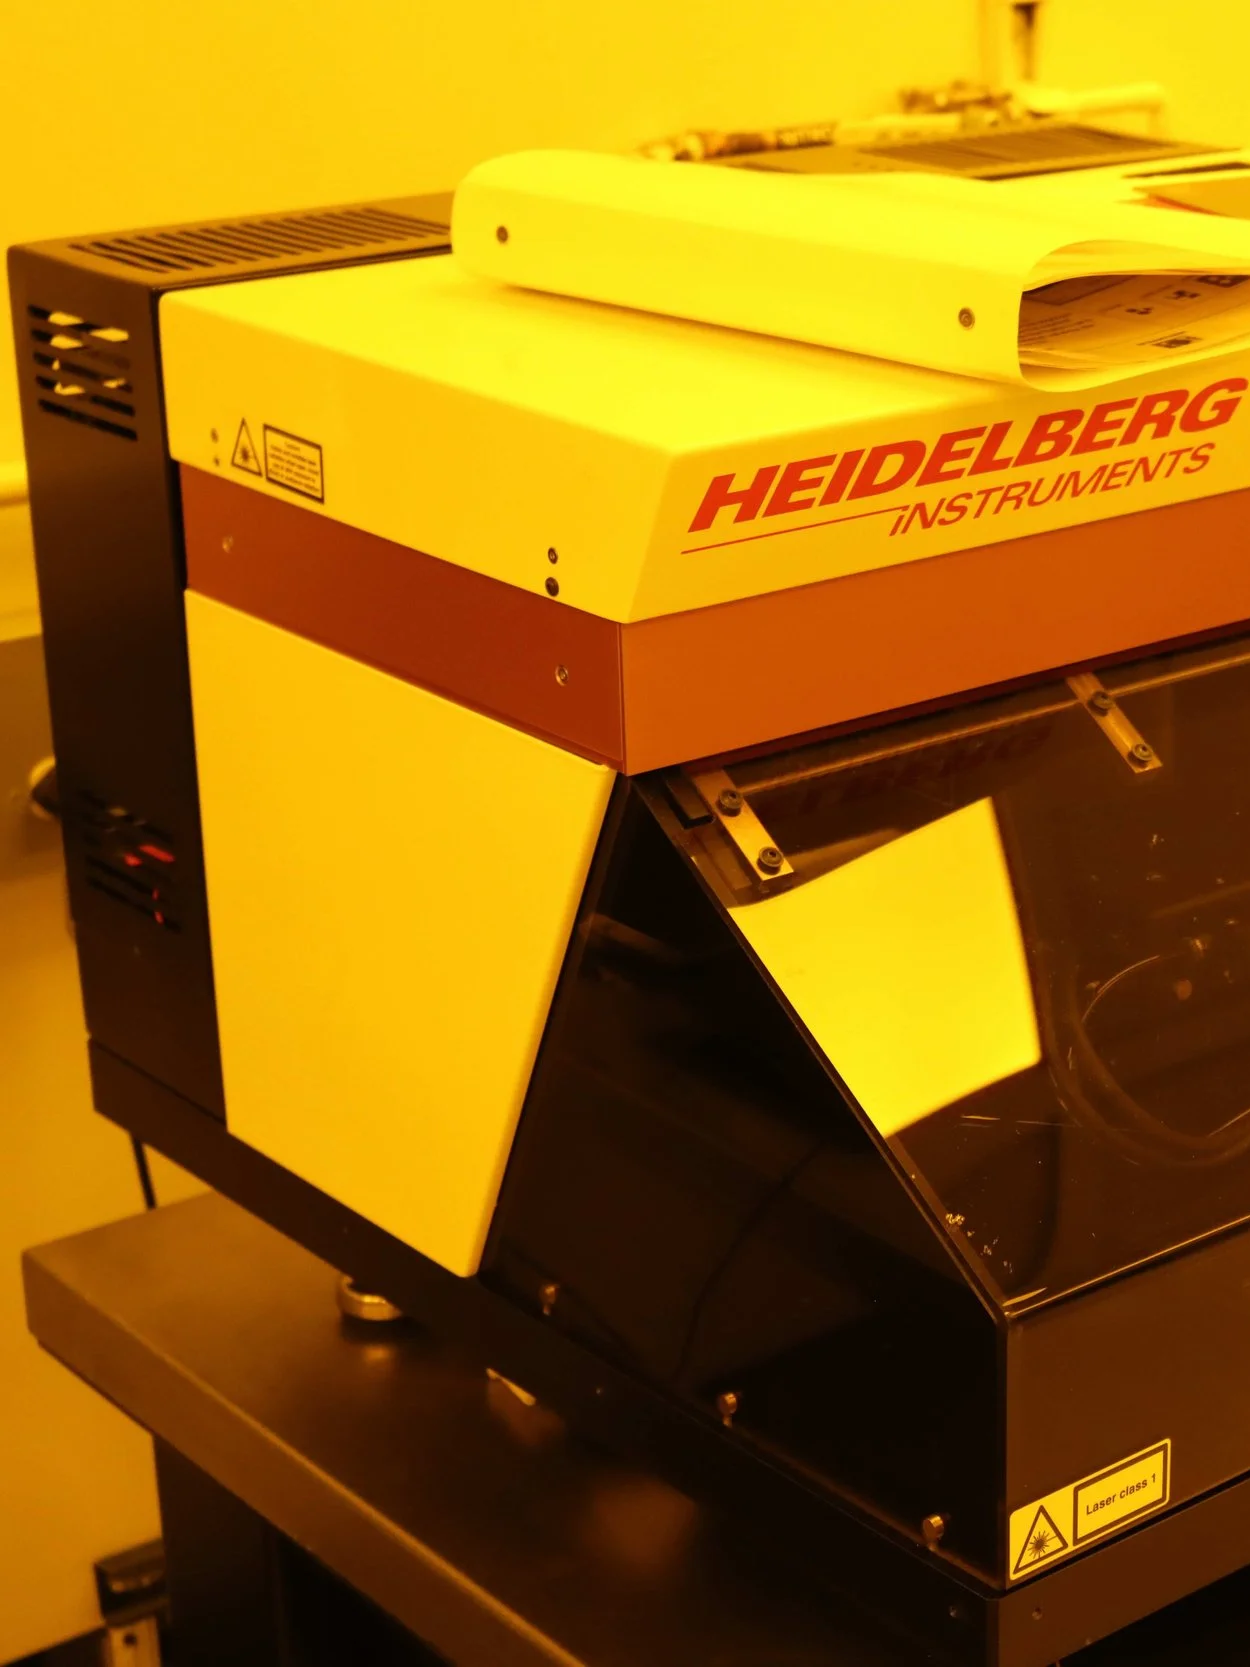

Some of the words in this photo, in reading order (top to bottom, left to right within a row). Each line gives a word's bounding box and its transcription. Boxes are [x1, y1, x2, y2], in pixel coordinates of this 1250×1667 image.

[688, 377, 1249, 533] HEIDELBERG
[1086, 1493, 1117, 1516] Laser
[1119, 1479, 1148, 1499] class
[1151, 1472, 1157, 1483] 1
